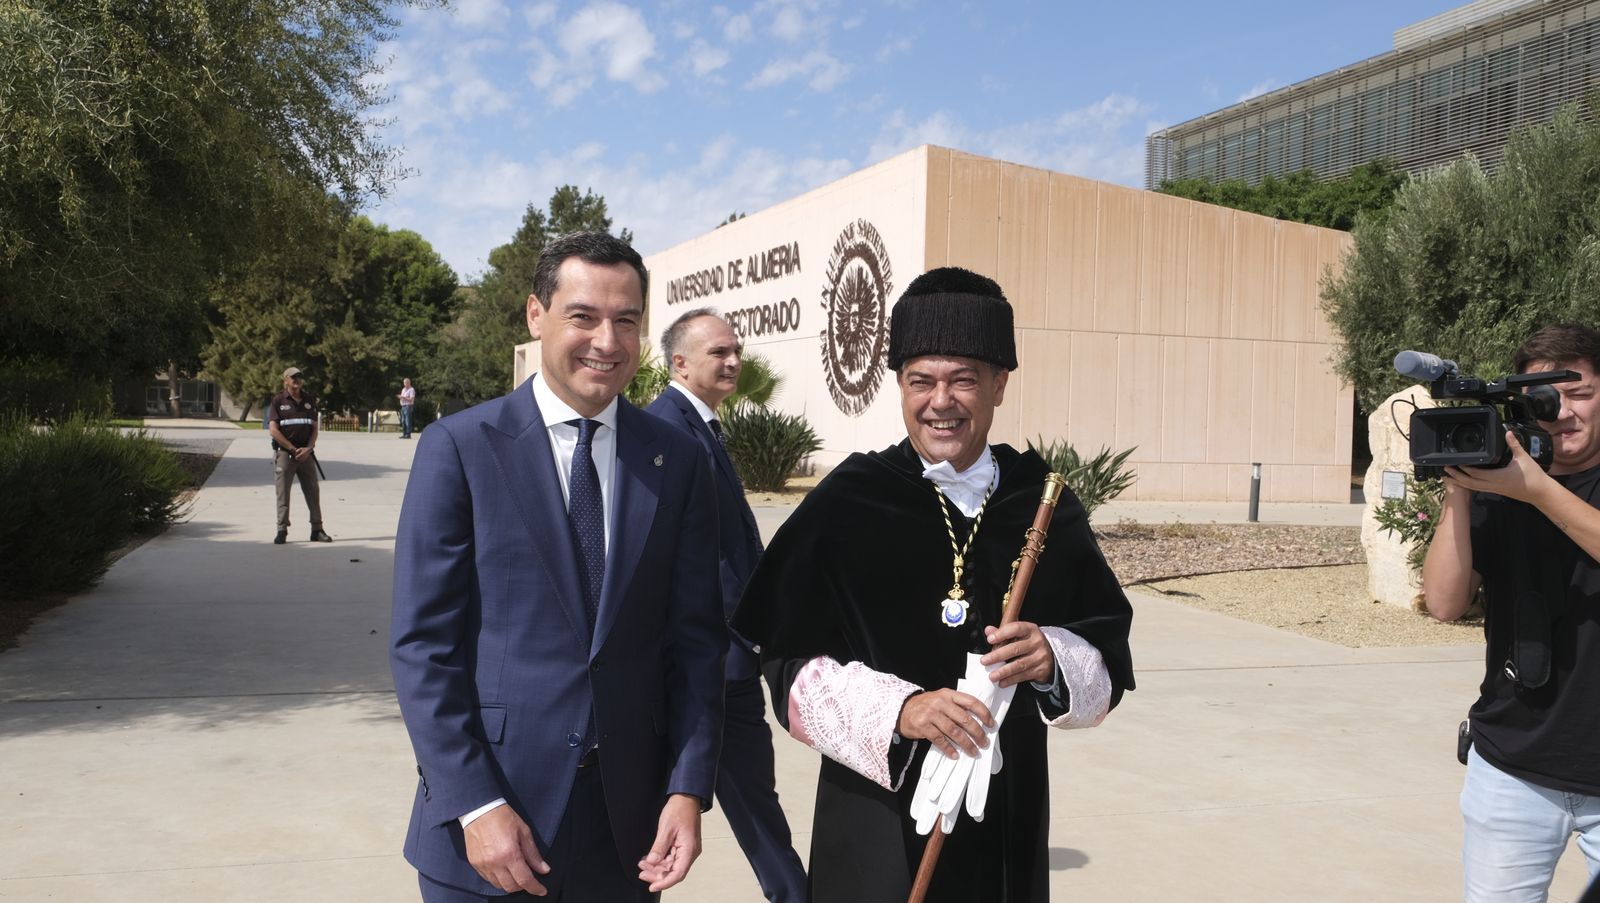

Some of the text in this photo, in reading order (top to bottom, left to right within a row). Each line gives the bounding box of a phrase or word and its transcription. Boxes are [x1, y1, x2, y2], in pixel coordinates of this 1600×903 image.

[666, 240, 802, 306] UNIVERSIDAD DE ALMERIA
